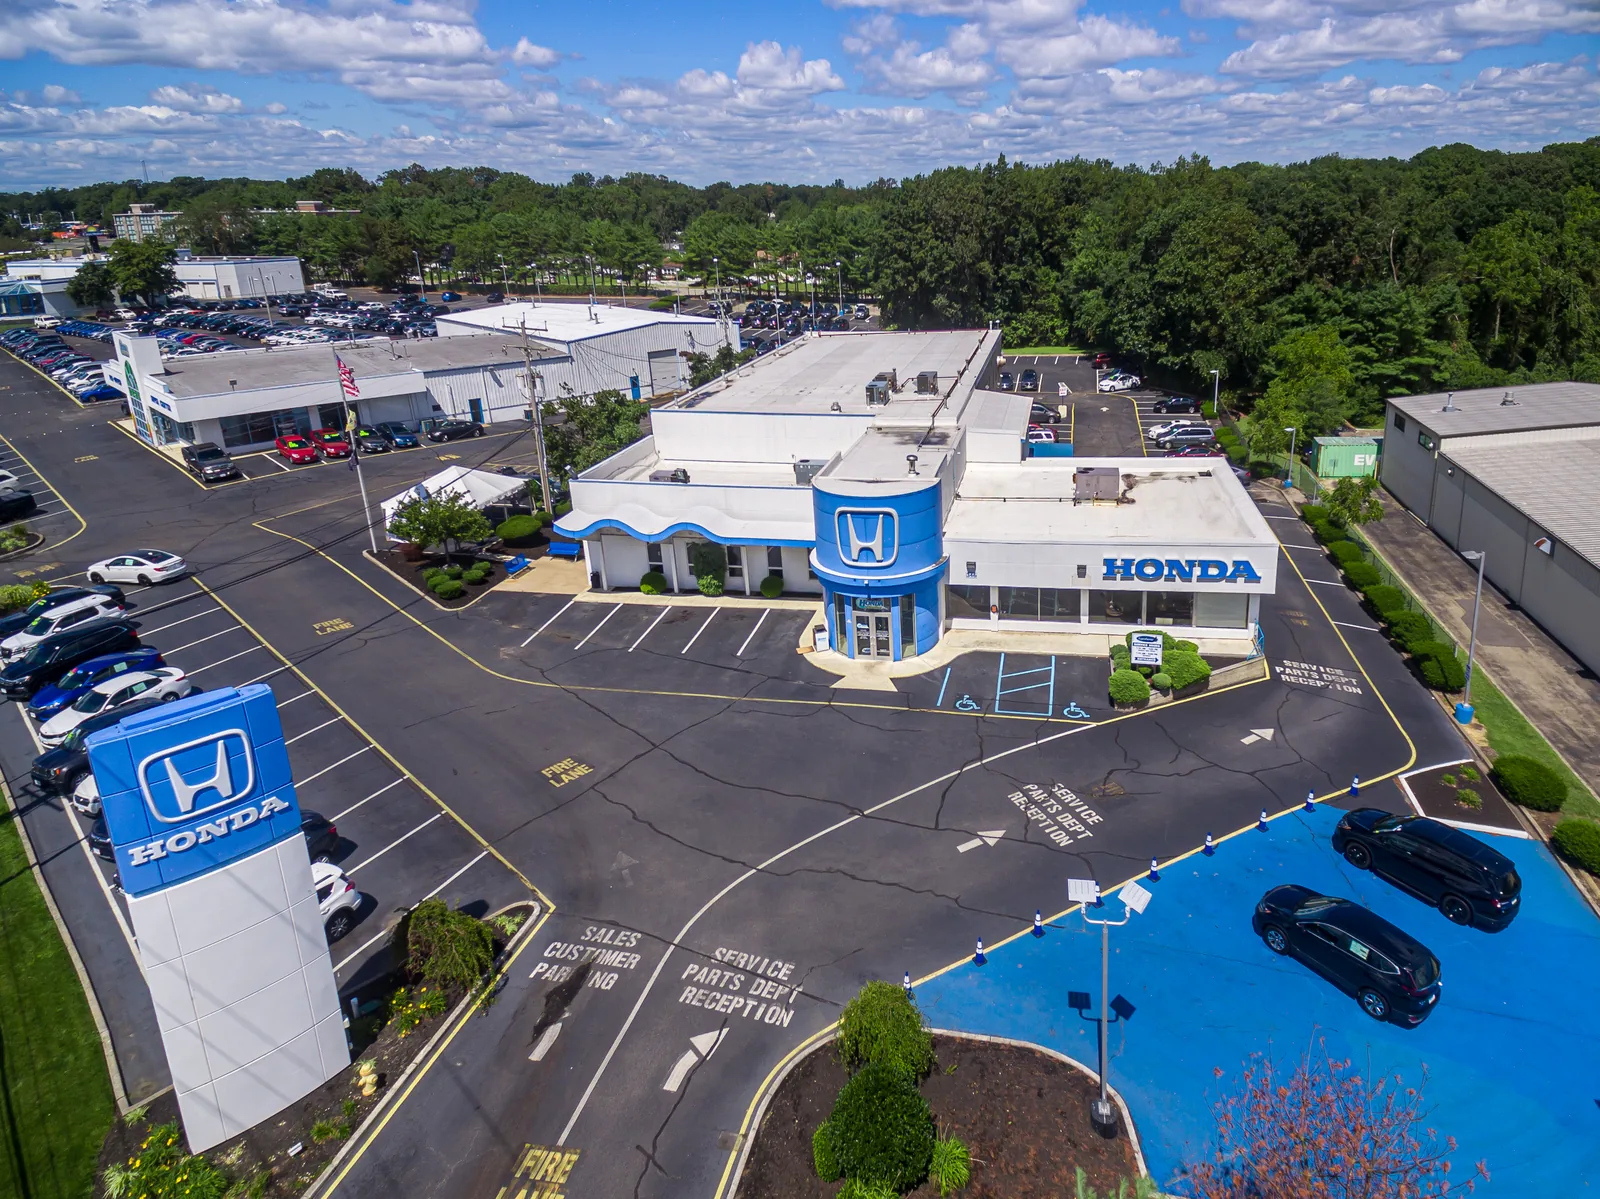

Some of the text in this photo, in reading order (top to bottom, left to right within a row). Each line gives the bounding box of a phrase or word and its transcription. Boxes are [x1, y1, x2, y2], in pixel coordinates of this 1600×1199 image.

[1354, 454, 1376, 466] EV
[1102, 558, 1262, 584] HONDA
[1275, 666, 1358, 686] PARTS DEPT
[1283, 660, 1344, 676] SERVICE
[1280, 674, 1363, 695] RECEPTION
[541, 758, 579, 778] FIRE
[549, 764, 594, 788] LANE
[1023, 783, 1063, 814] PARTS
[1056, 812, 1093, 840] DEPT
[1051, 783, 1104, 826] SERVICE
[128, 796, 289, 866] HONDA
[1007, 791, 1074, 847] RECEPTION
[581, 926, 642, 948] SALES
[529, 962, 619, 990] PARNG
[711, 947, 795, 981] SERVICE
[681, 963, 803, 1004] PARTS DEPT
[679, 986, 795, 1028] RECEPTION
[513, 1148, 580, 1184] FIRE
